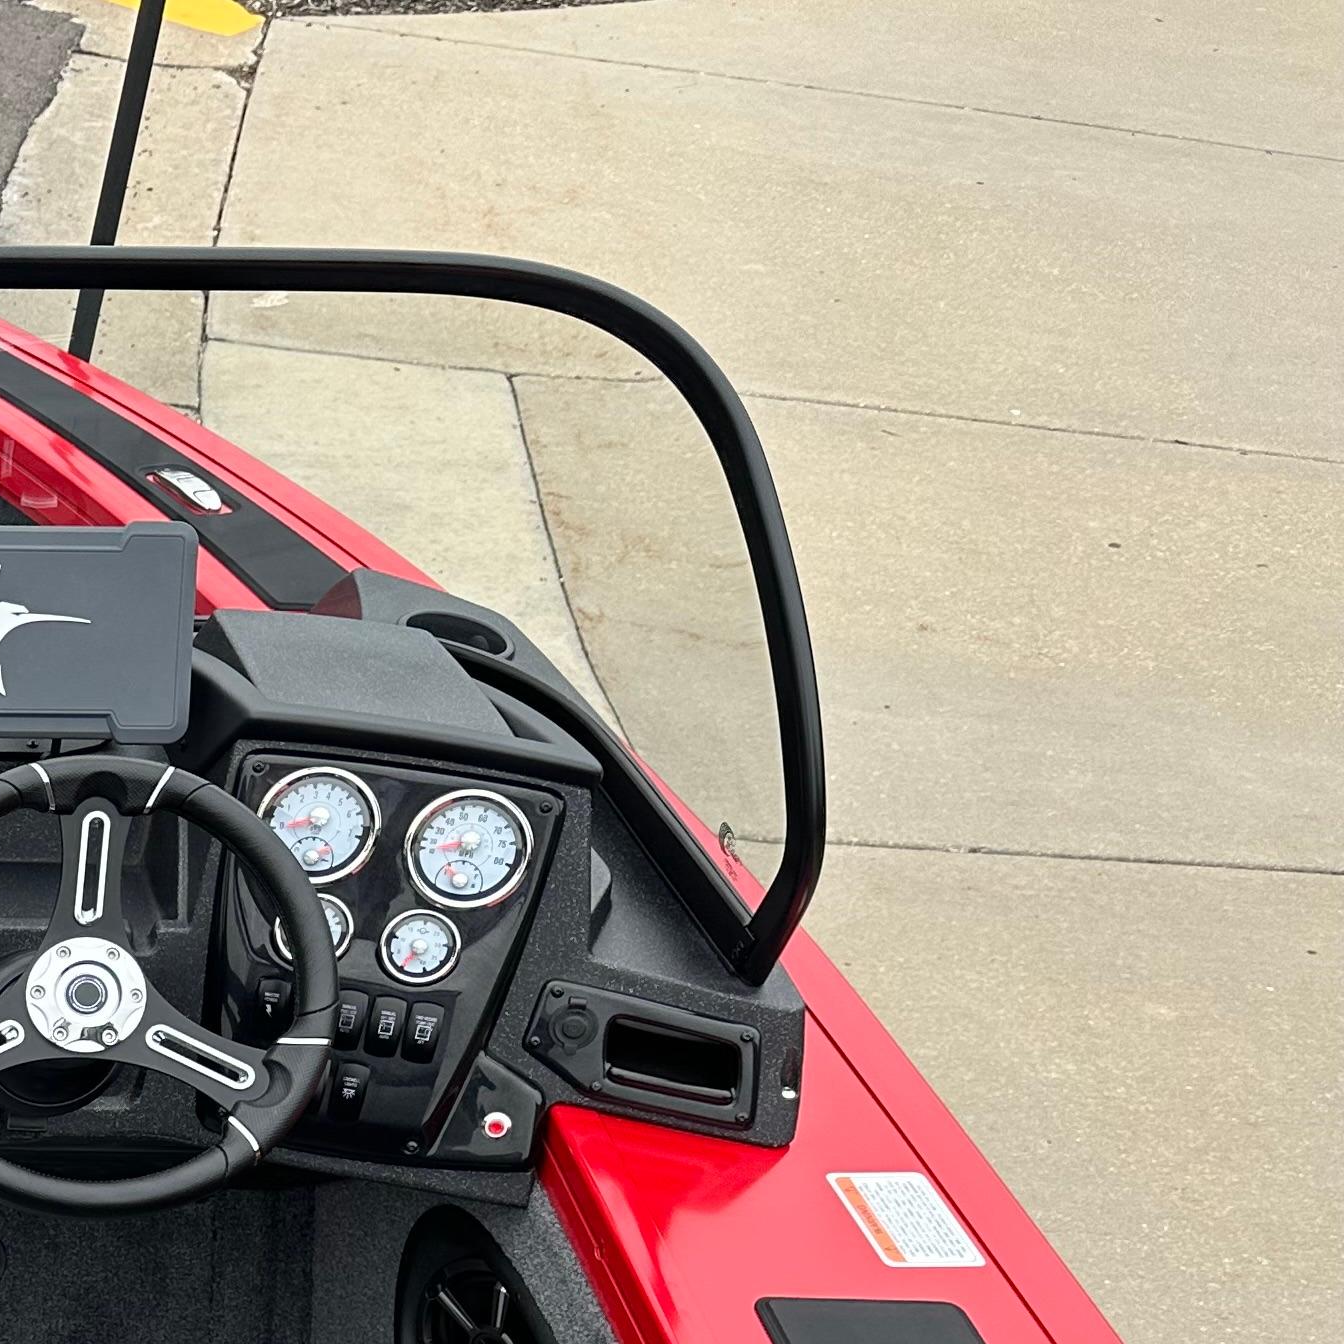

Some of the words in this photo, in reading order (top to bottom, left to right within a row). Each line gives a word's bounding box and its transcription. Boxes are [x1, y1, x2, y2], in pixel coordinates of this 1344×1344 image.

[459, 812, 469, 821] 50
[435, 827, 445, 835] 30
[493, 826, 503, 834] 70
[498, 840, 507, 848] 75
